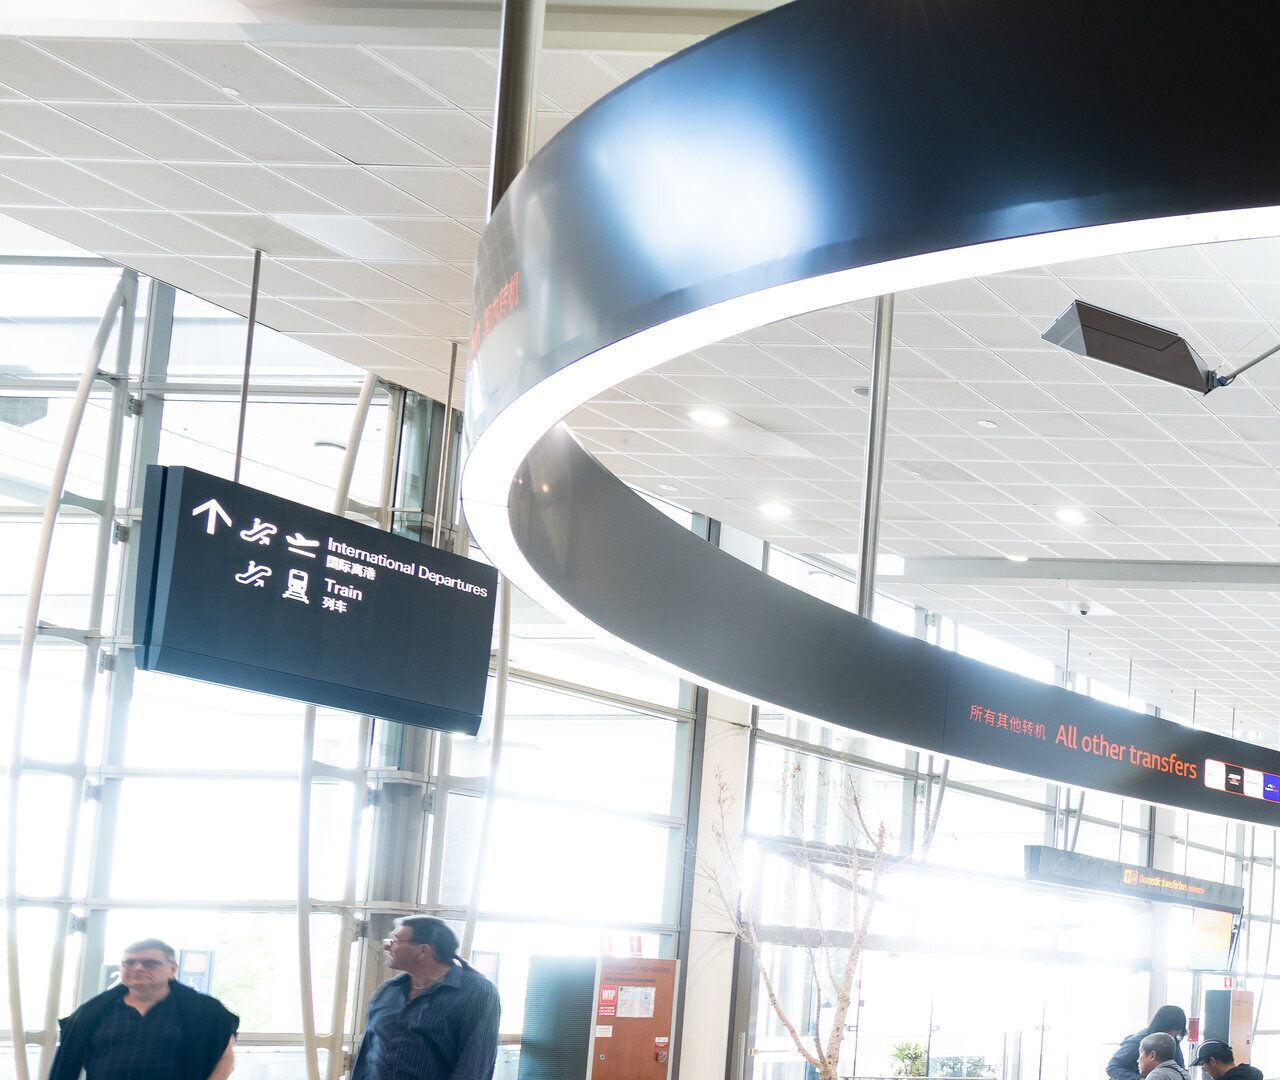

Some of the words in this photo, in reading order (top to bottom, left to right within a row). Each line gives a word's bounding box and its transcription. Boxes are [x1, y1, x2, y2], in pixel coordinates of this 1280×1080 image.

[328, 537, 415, 576] International
[418, 566, 488, 597] Departures
[323, 578, 363, 602] Train
[322, 597, 347, 614] 列车
[969, 704, 1047, 741] 所有其他转机
[1055, 724, 1078, 750] All
[1082, 734, 1126, 761] other
[1129, 749, 1198, 780] transfers
[1138, 873, 1162, 887] Domestic
[602, 990, 615, 1000] WIP
